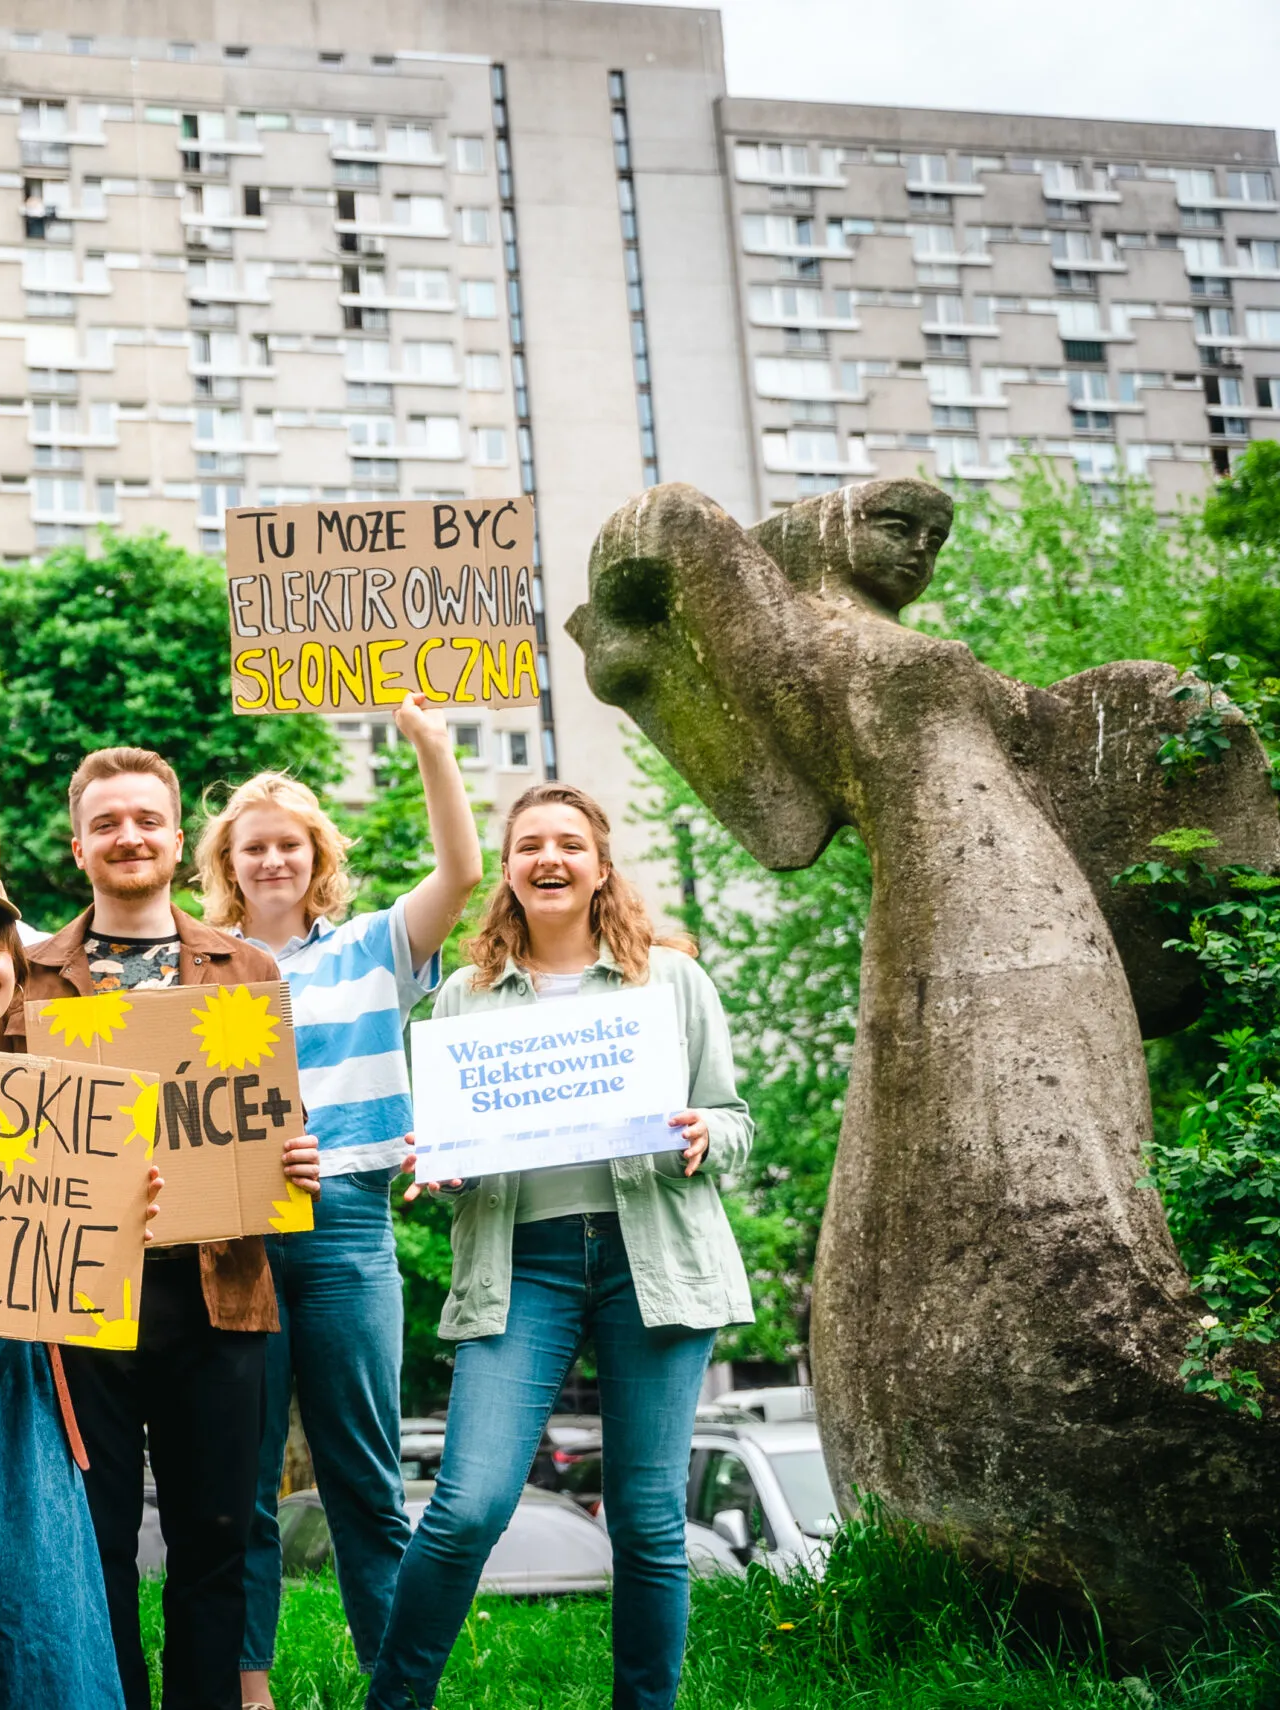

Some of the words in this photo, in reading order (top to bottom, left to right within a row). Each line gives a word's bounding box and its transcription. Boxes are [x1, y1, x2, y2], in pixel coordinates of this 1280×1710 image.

[236, 512, 295, 563] TU
[433, 500, 519, 550] BYĆ
[229, 564, 536, 638] ELEKTROWNIA
[234, 637, 540, 710] SŁONECZNA
[446, 1016, 640, 1064] Warszawskie
[459, 1044, 635, 1090] Elektrownie
[153, 1060, 292, 1151] ŃCE+
[471, 1075, 625, 1113] Słoneczne
